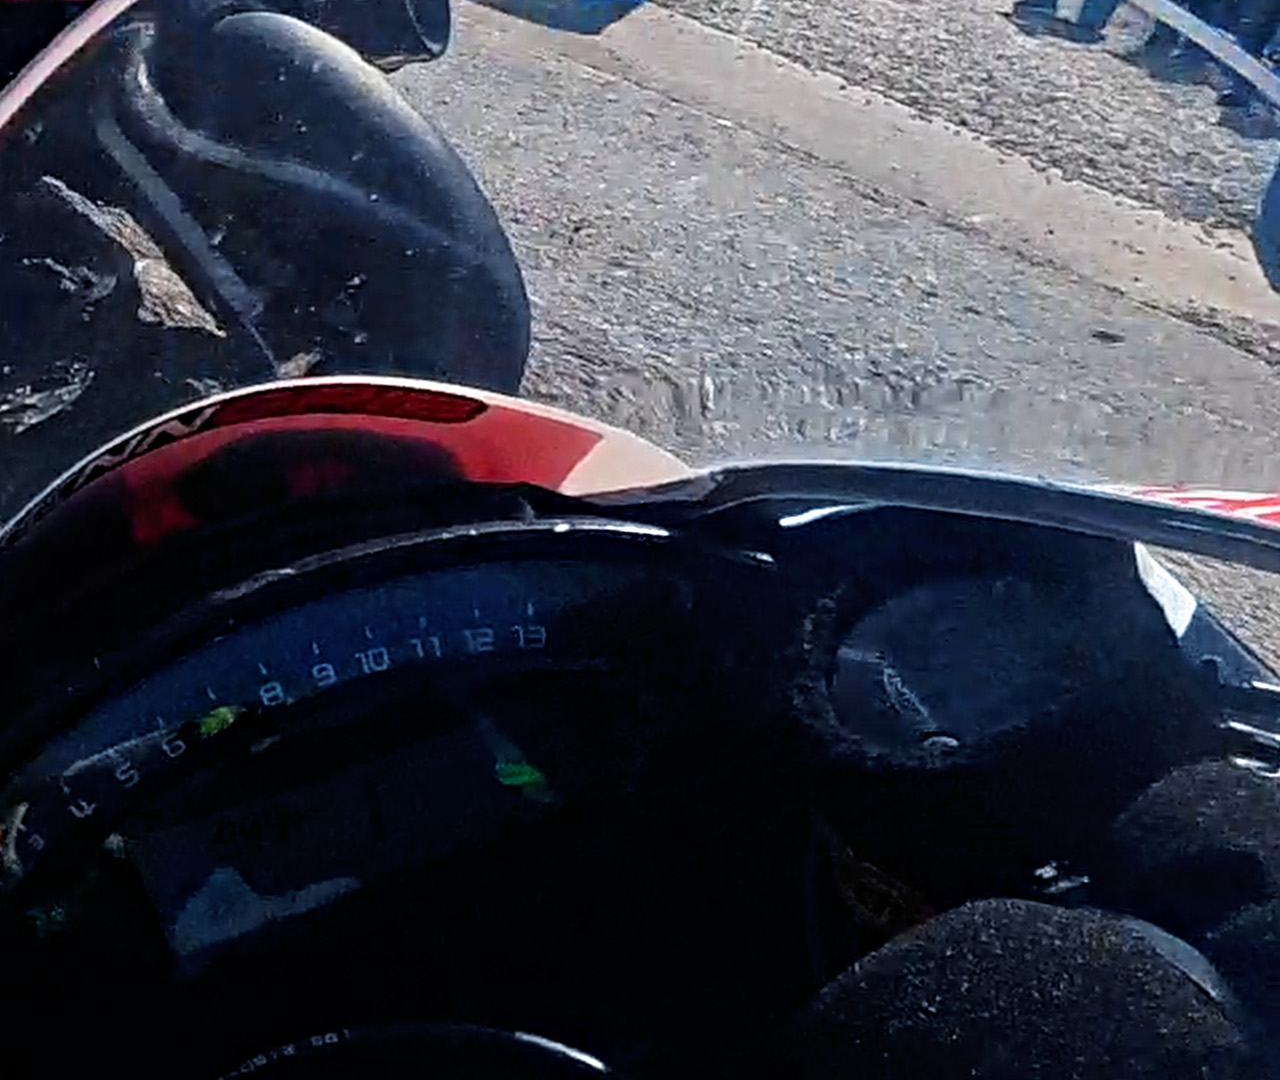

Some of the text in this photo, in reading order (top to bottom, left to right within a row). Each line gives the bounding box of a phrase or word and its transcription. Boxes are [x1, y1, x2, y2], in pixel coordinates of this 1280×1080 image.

[160, 733, 191, 762] 6
[258, 680, 286, 708] 8
[311, 660, 339, 687] 9
[354, 644, 393, 673] 10
[409, 633, 444, 661] 11
[462, 625, 498, 654] 12
[510, 622, 550, 650] 13
